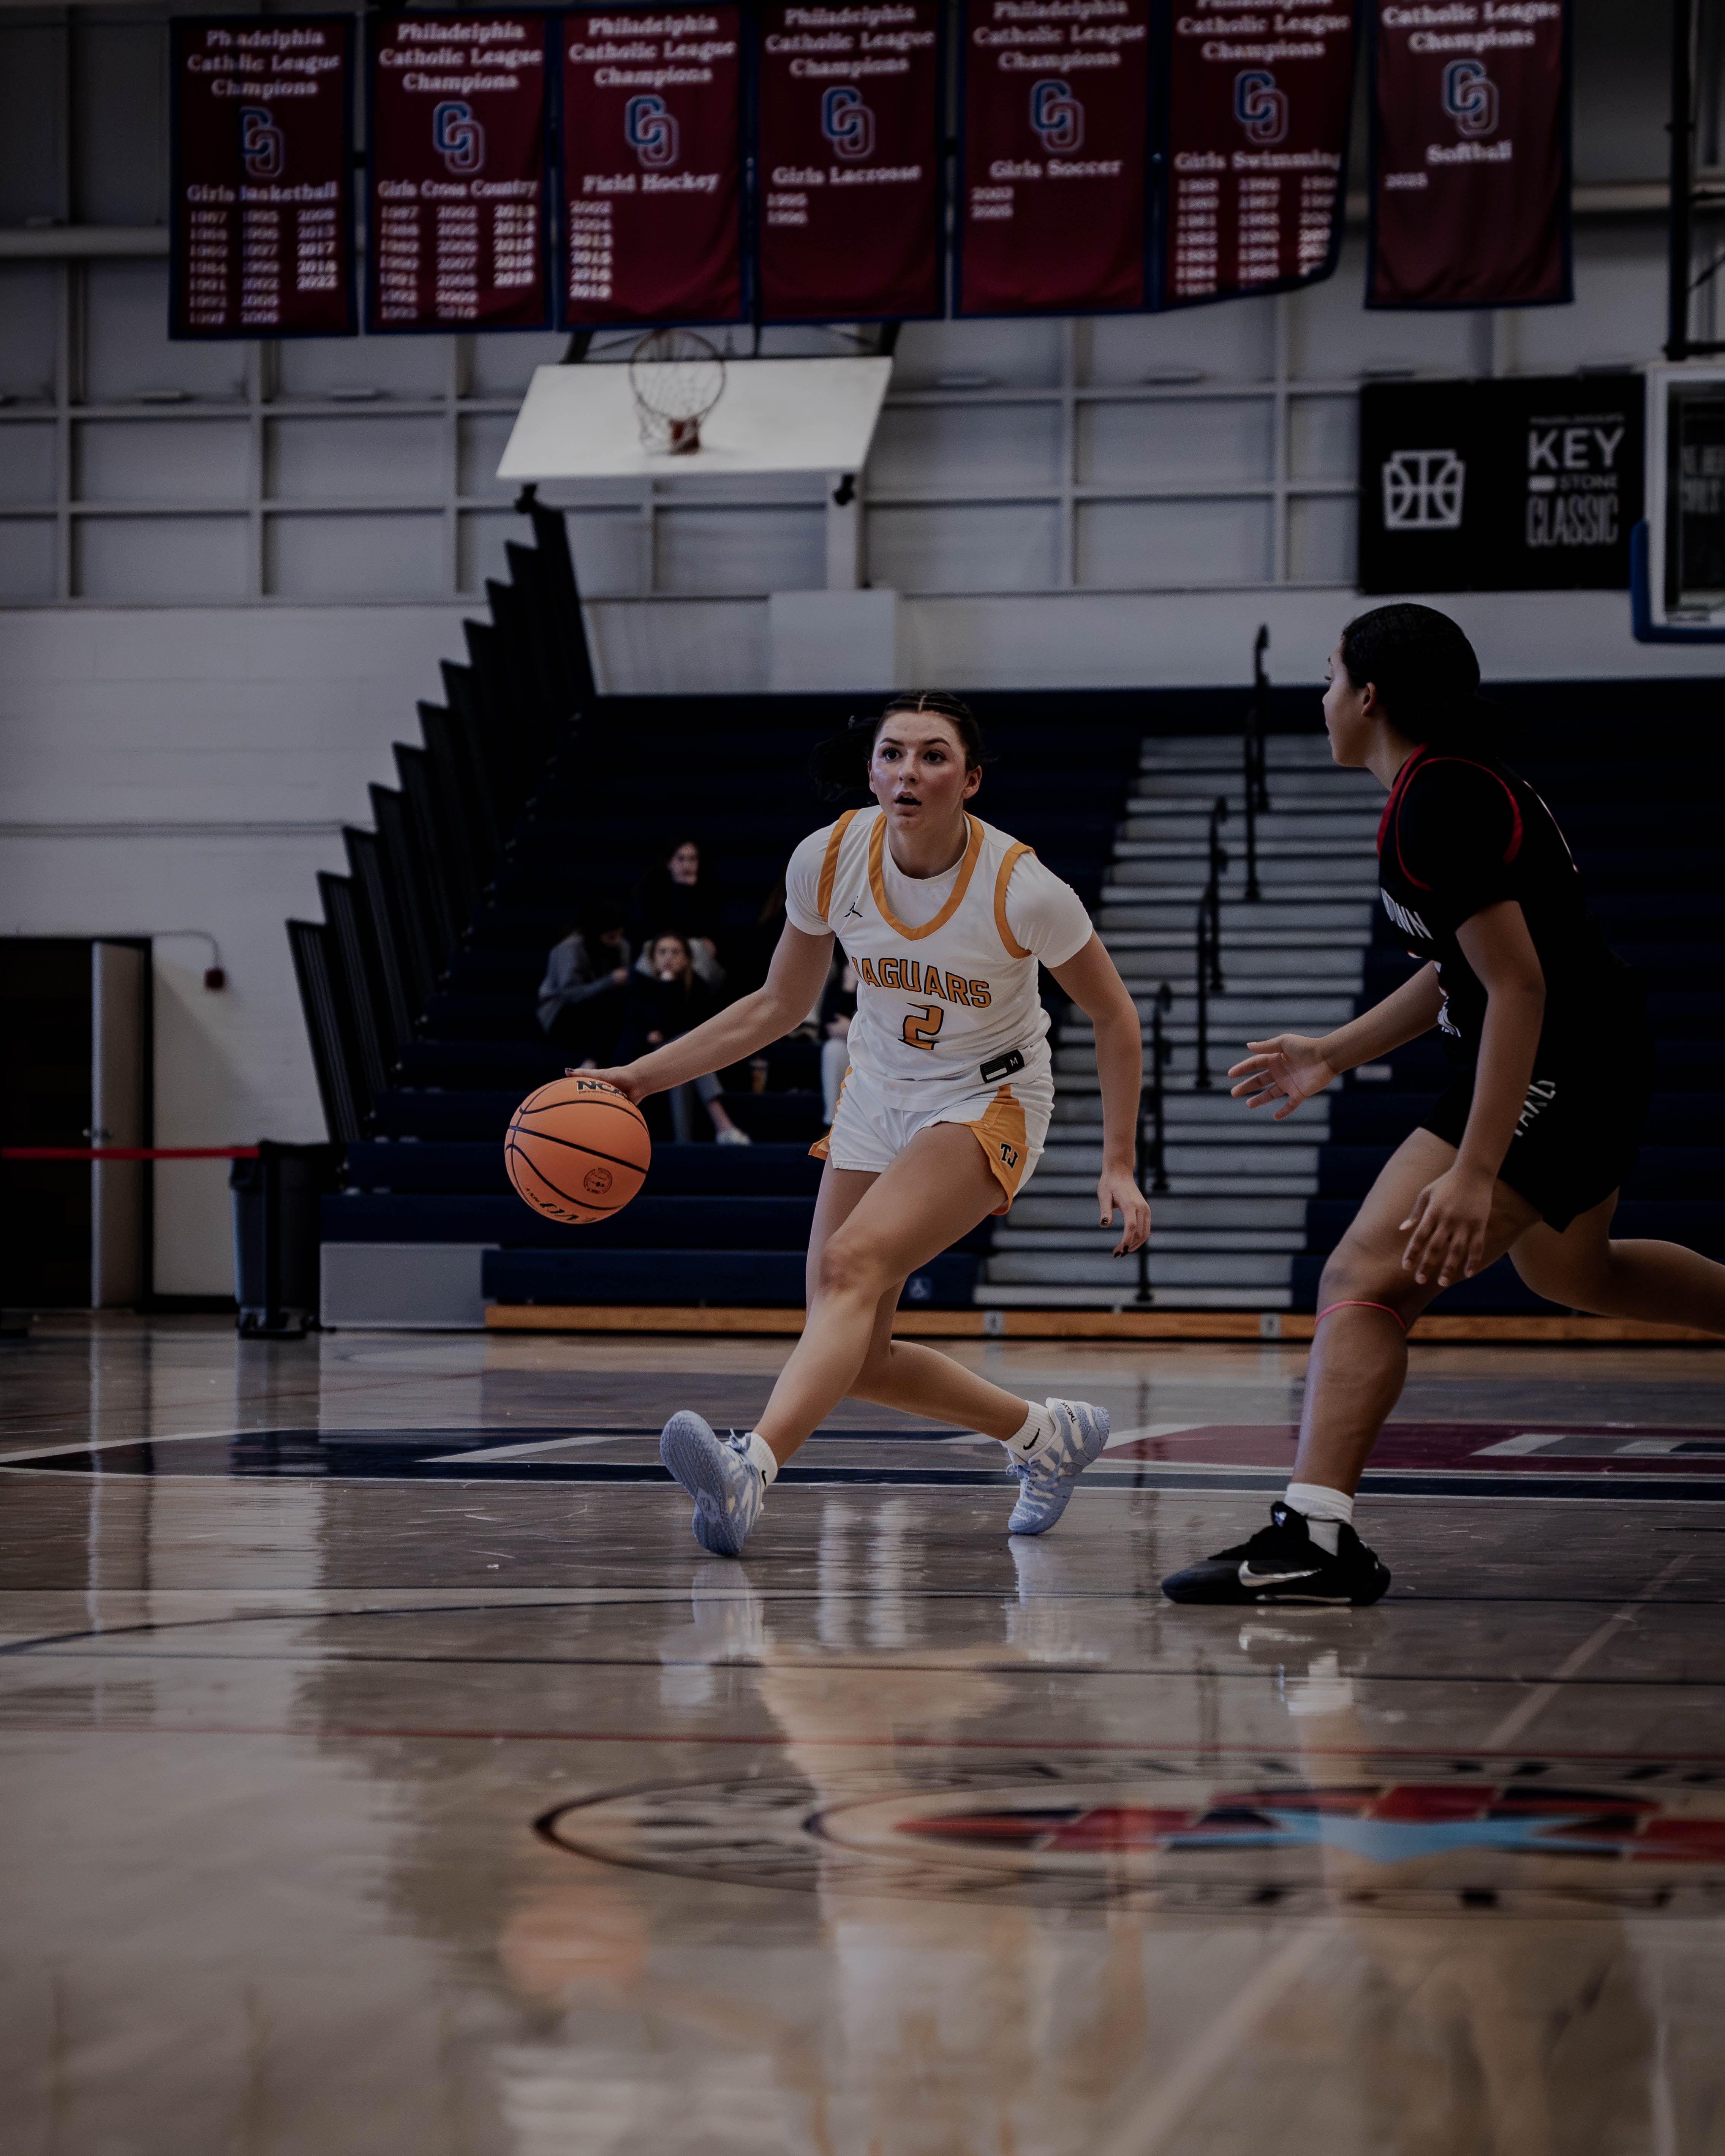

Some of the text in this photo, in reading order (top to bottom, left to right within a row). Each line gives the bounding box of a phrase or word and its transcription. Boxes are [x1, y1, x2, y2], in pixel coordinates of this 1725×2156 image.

[785, 5, 915, 27] Philadelphia
[1177, 14, 1349, 35] Catholic League
[1382, 2, 1559, 26] Catholic League
[398, 22, 525, 44] Philadelphia
[588, 16, 718, 37] Philadelphia
[973, 25, 1145, 45] Catholic League
[207, 30, 324, 50] Phadelphia
[765, 32, 934, 52] Catholic League
[1409, 28, 1534, 52] Champions
[379, 48, 542, 69] Catholic League
[569, 41, 735, 62] Catholic League
[998, 50, 1120, 72] Champions
[1202, 41, 1325, 63] Champions
[187, 54, 339, 74] Cathlic League
[790, 57, 909, 78] Champions
[403, 73, 519, 94] Champions
[594, 66, 712, 88] Champions
[1175, 152, 1226, 170] Girls
[1427, 141, 1512, 163] Softball
[772, 166, 920, 185] Girls Lacrosse
[990, 160, 1121, 179] Girls Soccer
[378, 180, 417, 197] Girls
[470, 180, 537, 197] Country
[583, 172, 718, 192] Field Hockey
[187, 185, 235, 202] Girls
[298, 241, 335, 257] 2017
[1529, 428, 1624, 469] KEY
[1526, 493, 1618, 547] CLASSIC
[898, 1003, 944, 1050] 2
[1009, 1057, 1018, 1066] M
[1000, 1143, 1018, 1169] TJ
